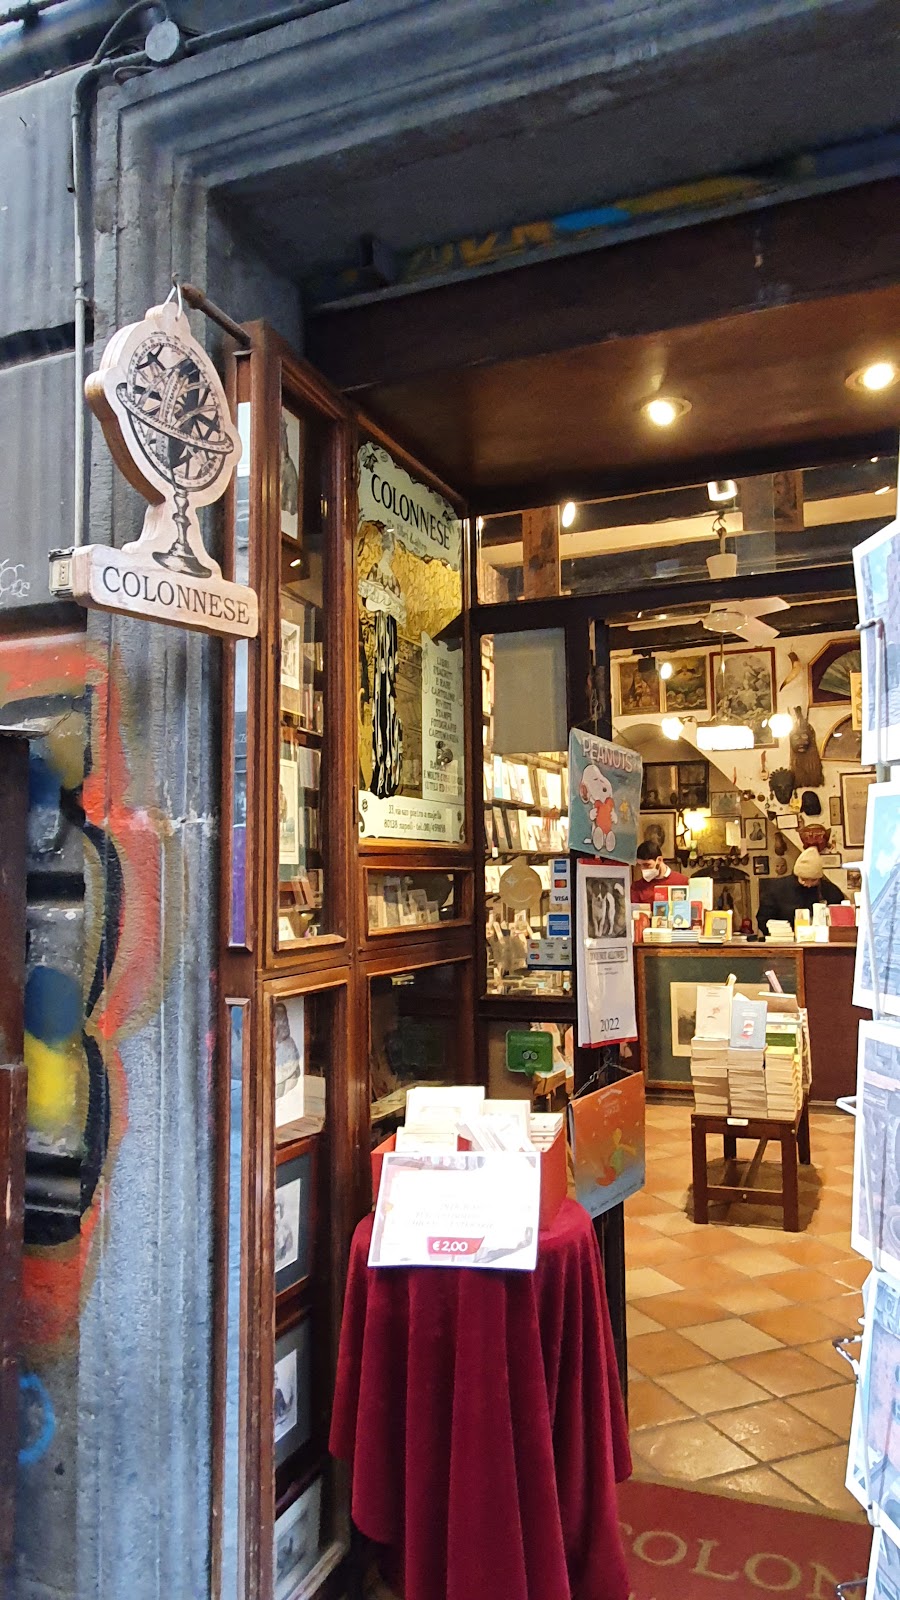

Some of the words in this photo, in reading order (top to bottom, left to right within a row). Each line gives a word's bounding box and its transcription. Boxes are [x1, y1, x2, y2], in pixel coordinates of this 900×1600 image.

[371, 473, 450, 550] COLONNESE
[102, 566, 250, 625] COLONNESE
[582, 737, 634, 773] PEANUTS
[600, 1017, 620, 1032] 2022
[618, 1521, 869, 1600] OLON
